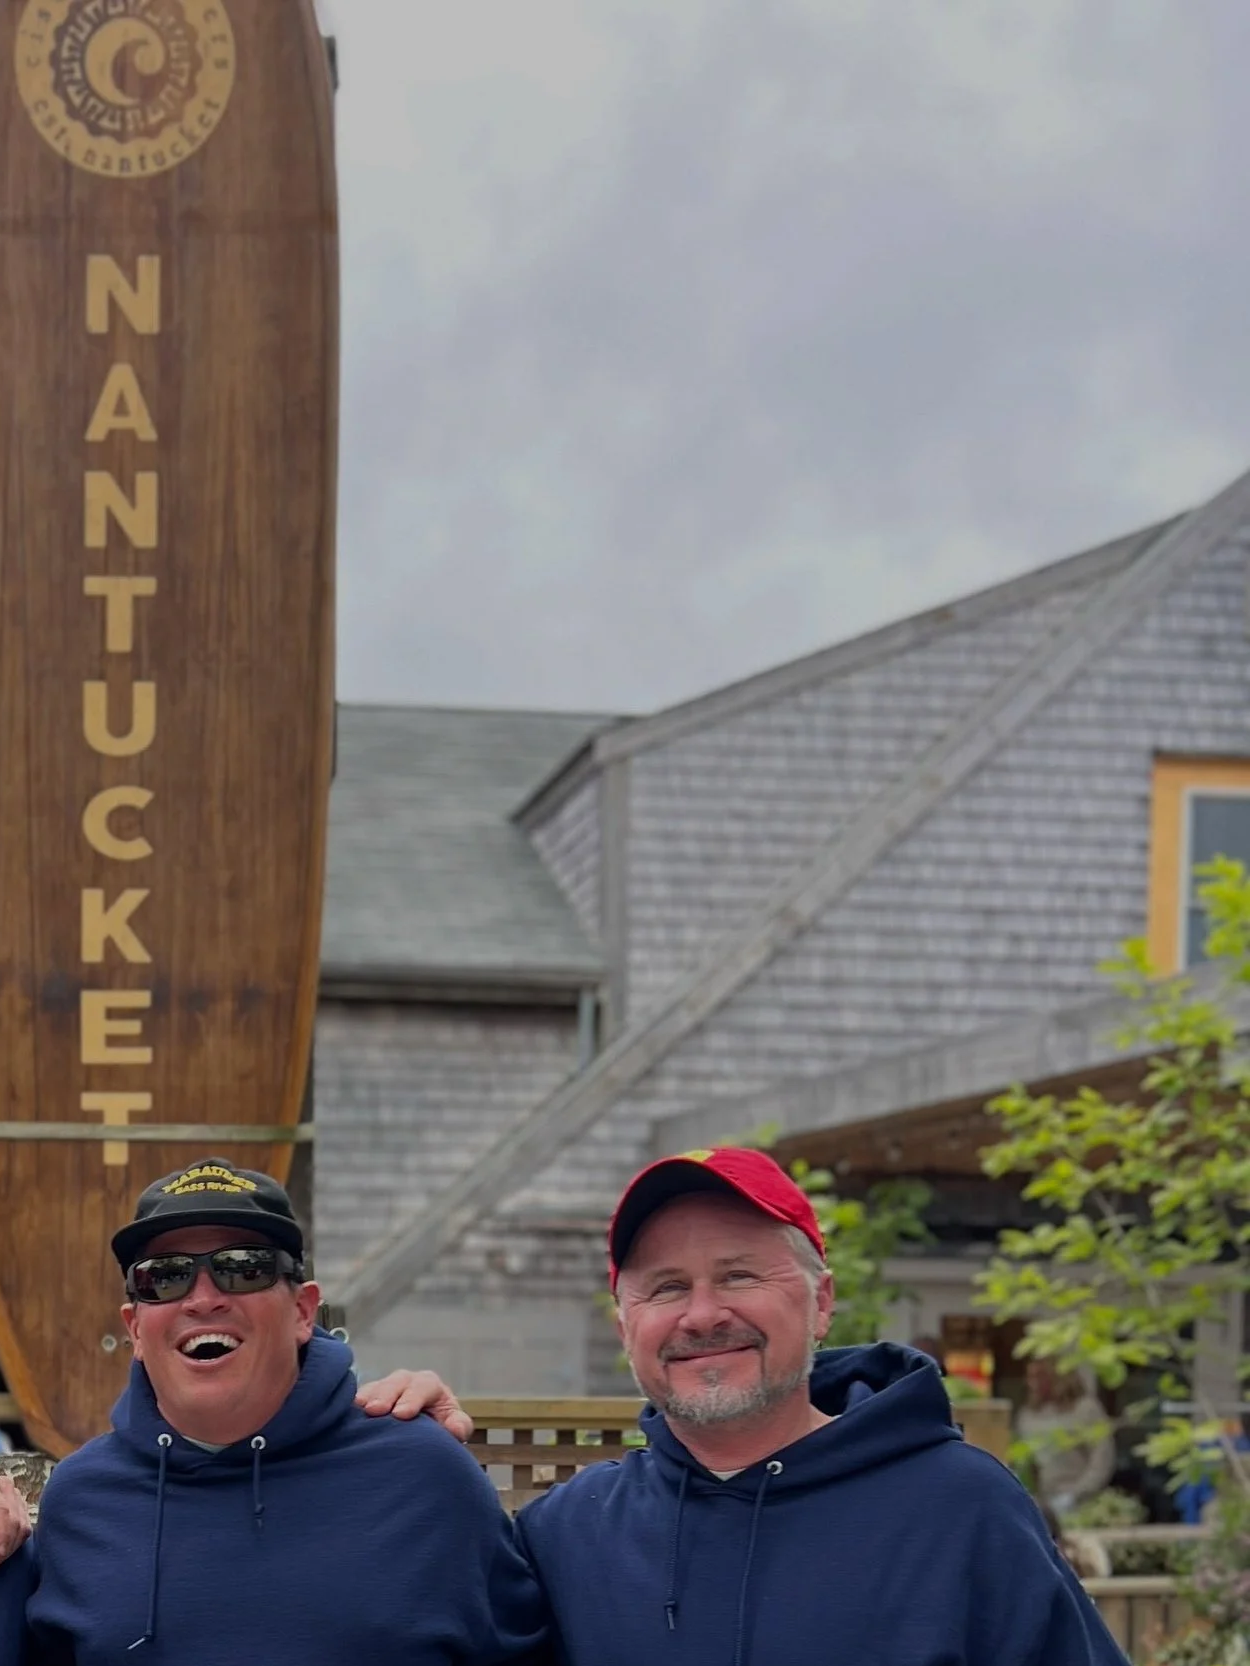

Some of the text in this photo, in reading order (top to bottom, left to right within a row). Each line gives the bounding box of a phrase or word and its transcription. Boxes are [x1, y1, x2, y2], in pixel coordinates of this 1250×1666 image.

[25, 2, 56, 69] cis
[202, 6, 229, 71] ers
[83, 98, 221, 173] nantucket
[81, 254, 160, 1165] NANTUCKET
[174, 1181, 242, 1195] BASS RIVER
